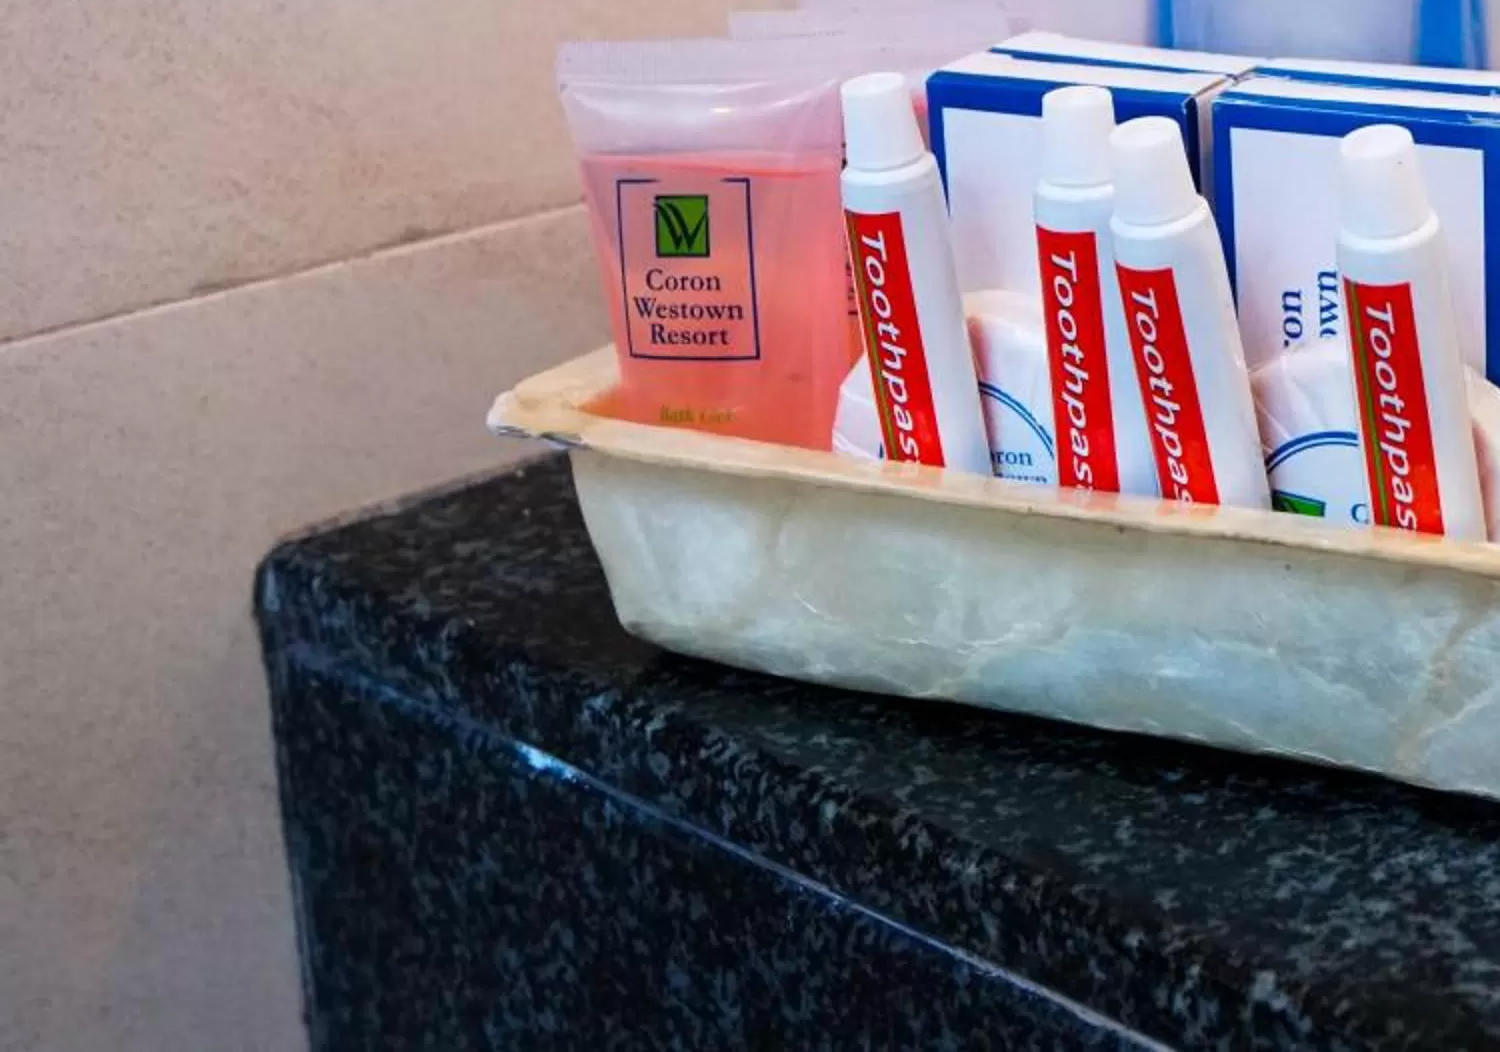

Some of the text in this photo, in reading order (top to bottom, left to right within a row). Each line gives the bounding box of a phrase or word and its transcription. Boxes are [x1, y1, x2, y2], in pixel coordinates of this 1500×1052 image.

[633, 295, 745, 321] Westown
[645, 268, 722, 292] Coron
[649, 323, 730, 346] Resort
[860, 229, 920, 463] Toothpas
[1051, 249, 1094, 493] Toothpas
[1131, 287, 1194, 503] Toothpas
[1365, 301, 1418, 531] Toothpas
